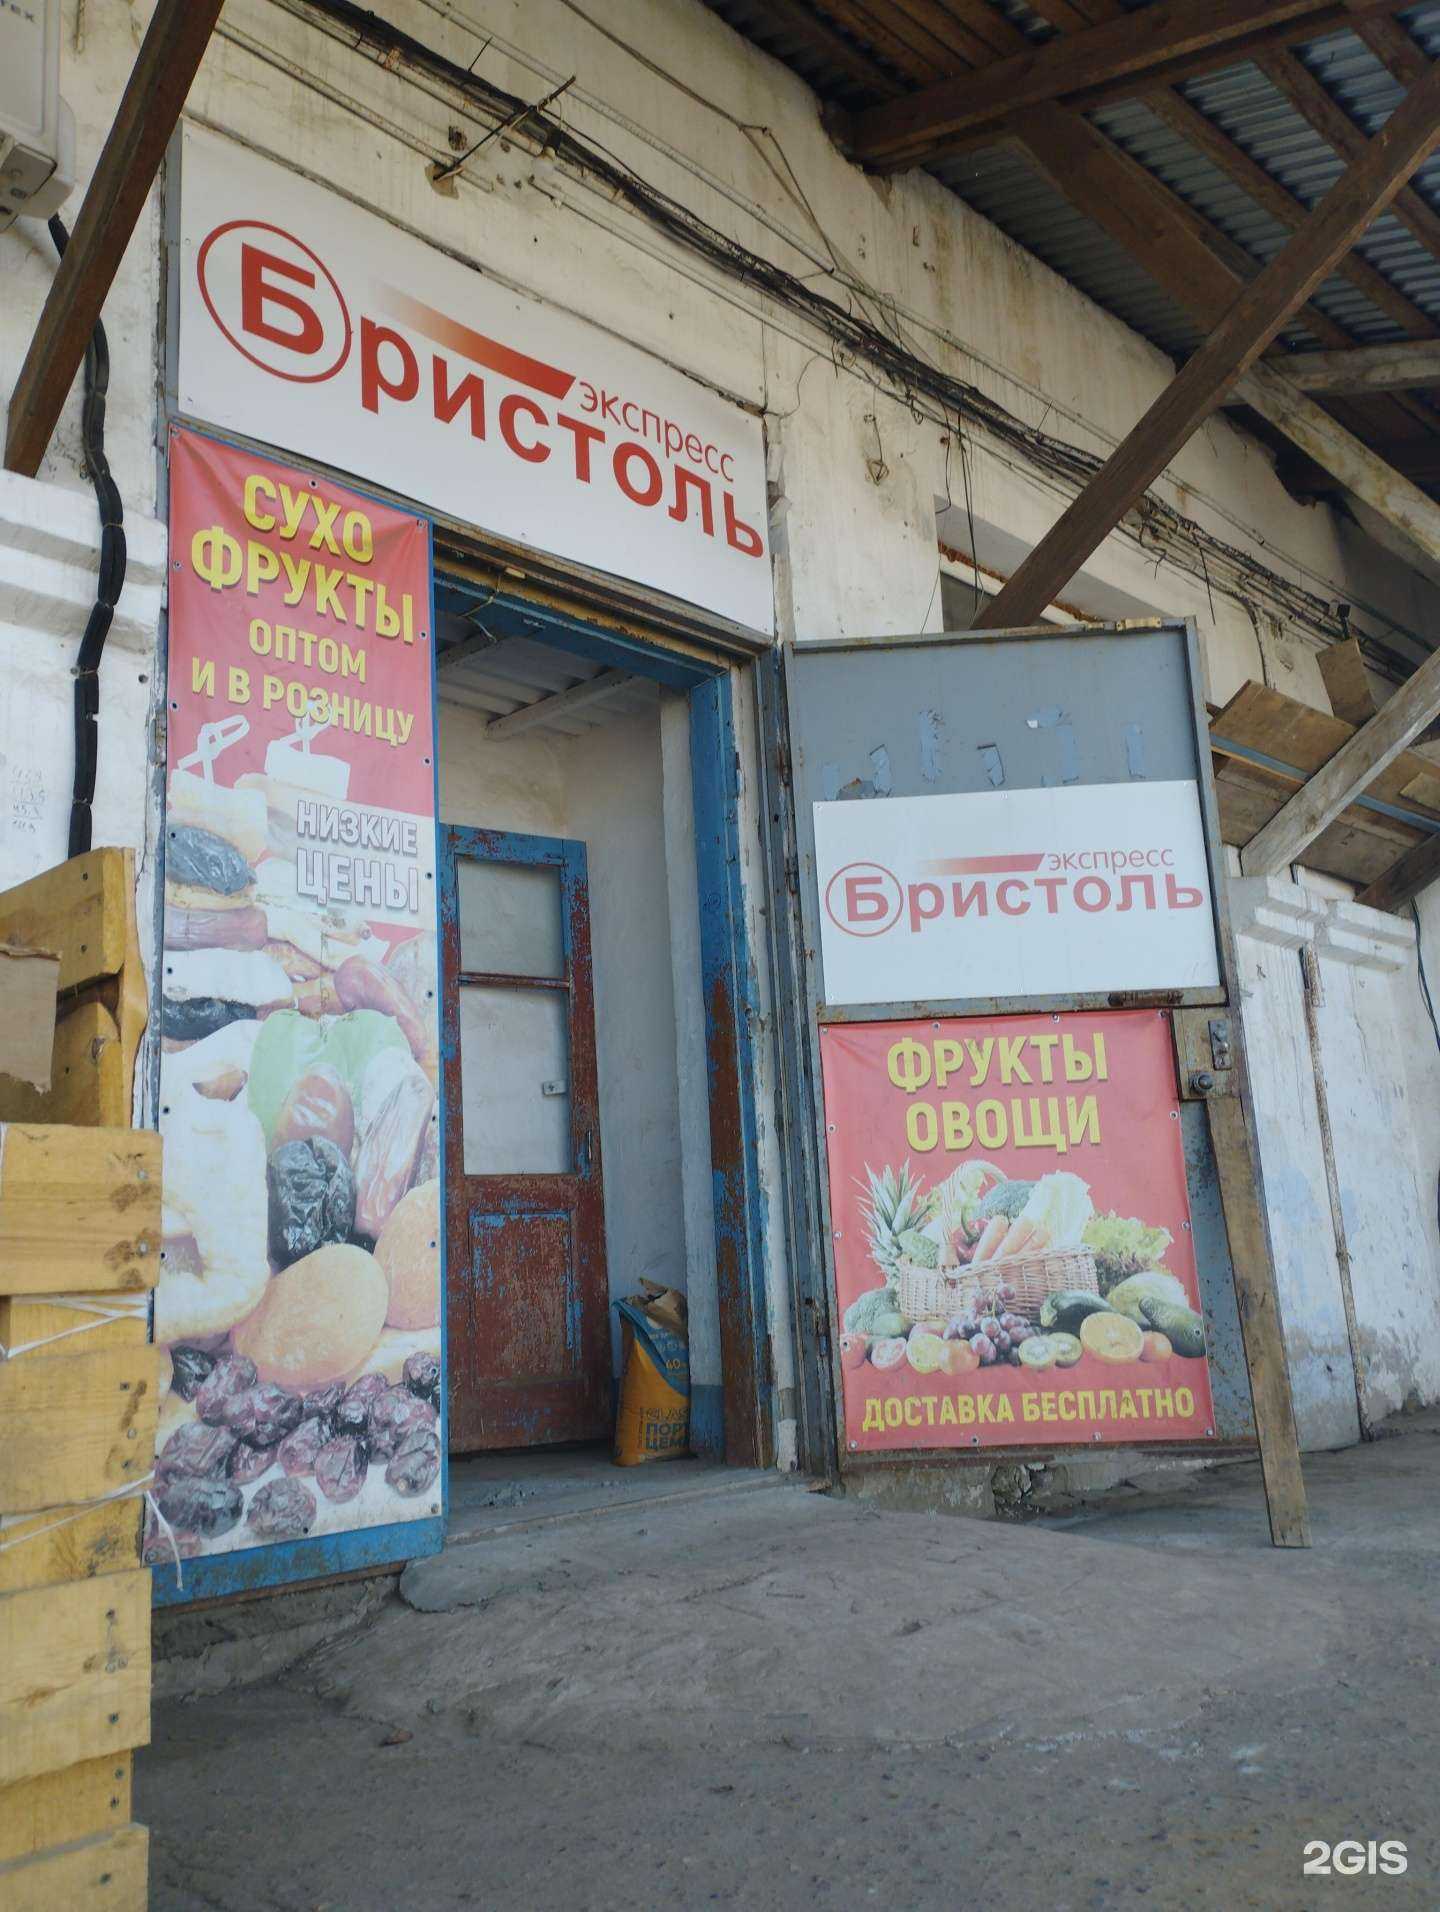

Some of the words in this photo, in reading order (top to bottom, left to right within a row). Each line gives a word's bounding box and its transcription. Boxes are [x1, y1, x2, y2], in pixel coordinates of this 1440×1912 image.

[196, 219, 764, 559] Бристоль
[579, 381, 735, 484] экспресс
[243, 474, 374, 564] СУХО
[191, 525, 414, 645] ФРУКТЫ
[249, 618, 367, 684] ОПТОМ
[192, 657, 215, 698] И
[228, 666, 251, 705] В
[263, 674, 414, 747] РОЗНИЦУ
[296, 800, 418, 855] НИЗКИЕ
[296, 848, 419, 913] ЦЕНЫ
[1049, 848, 1175, 874] экспресс
[825, 862, 1204, 938] Бристоль
[887, 1032, 1109, 1094] ФРУКТЫ
[906, 1096, 1101, 1154] ОВОЩИ
[862, 1394, 1015, 1432] ДОСТАВКА
[1022, 1387, 1195, 1422] БЕСПЛАТНО
